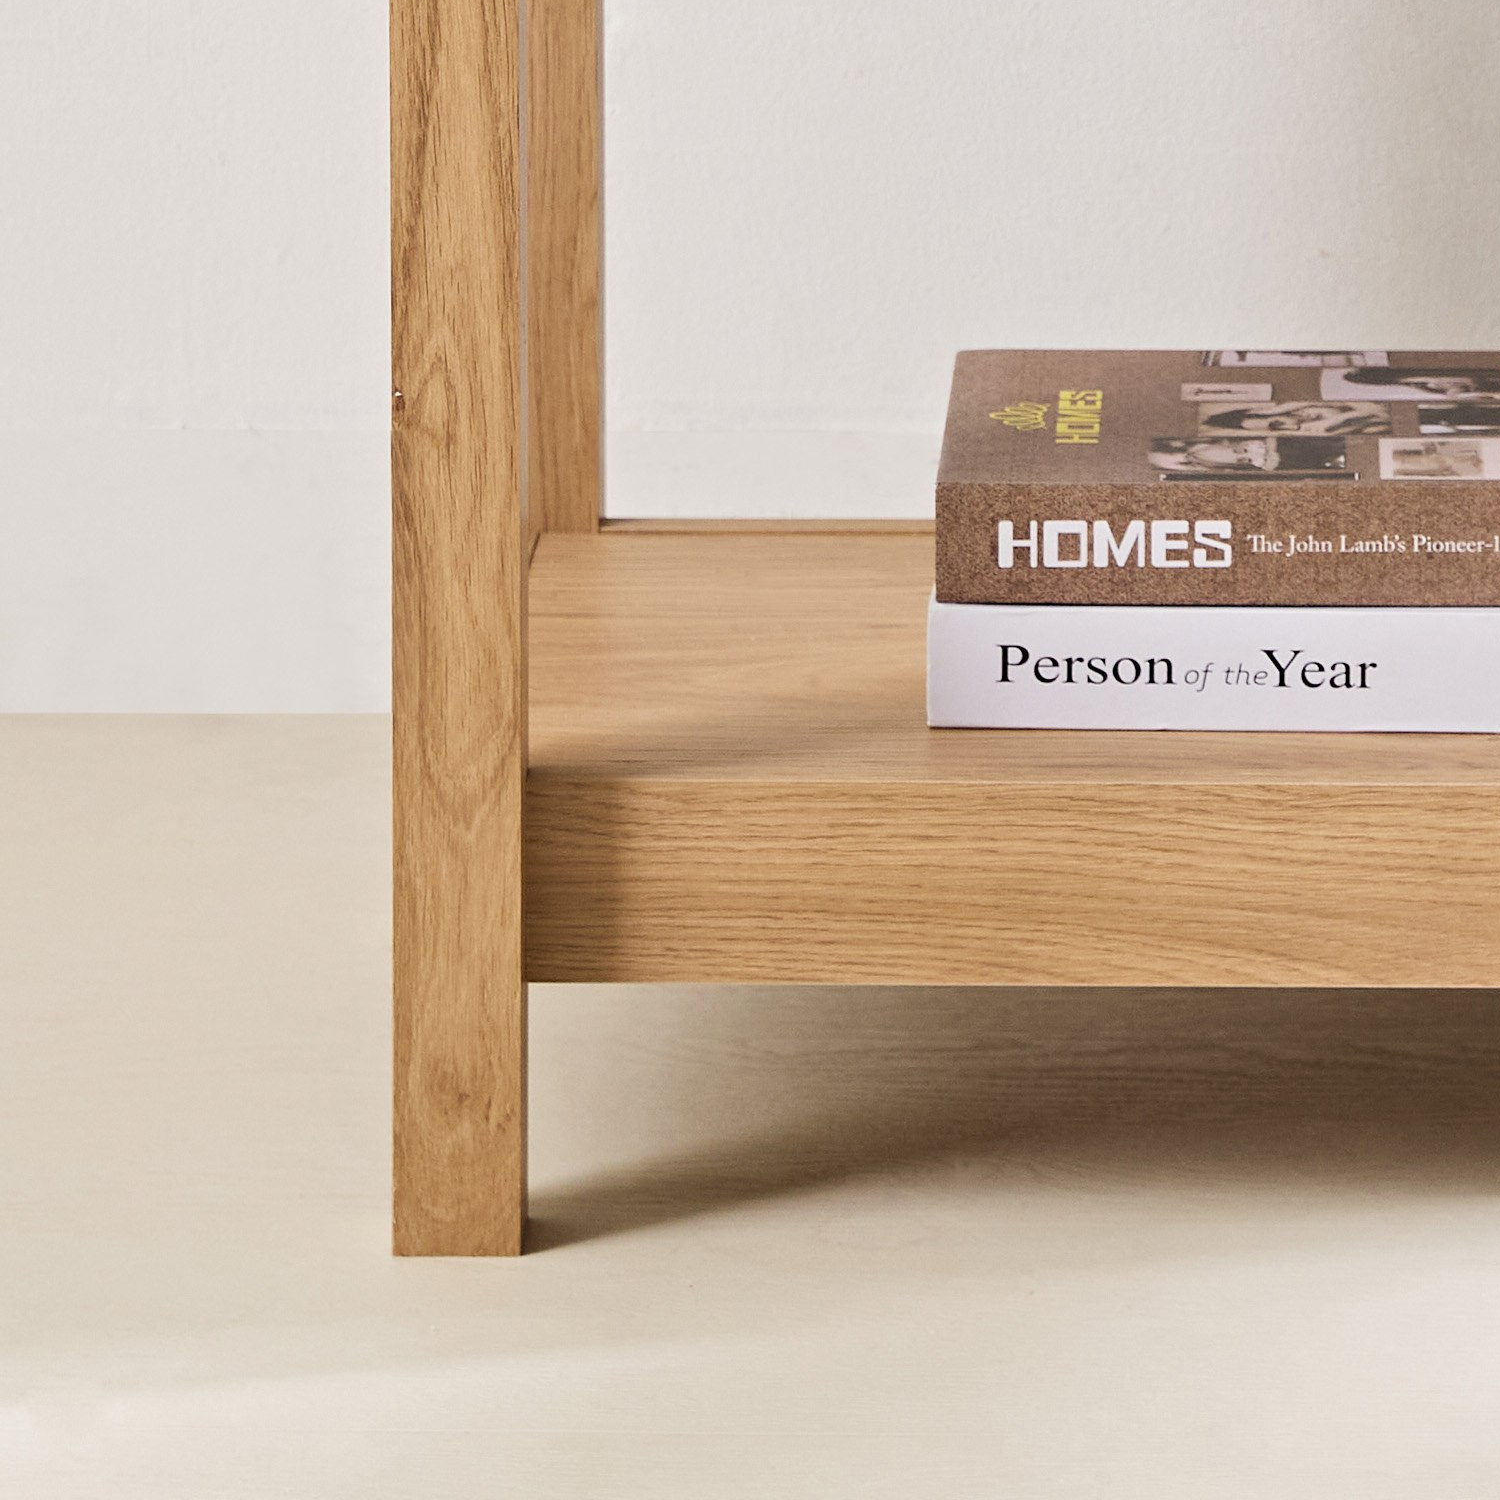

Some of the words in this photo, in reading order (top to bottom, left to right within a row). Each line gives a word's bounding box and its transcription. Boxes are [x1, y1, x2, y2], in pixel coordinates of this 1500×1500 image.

[1055, 390, 1103, 444] HOMES
[998, 519, 1232, 568] HOMES
[1246, 534, 1283, 553] The
[1285, 534, 1333, 557] John
[995, 644, 1177, 685] Person
[1184, 662, 1215, 693] of
[1224, 663, 1268, 686] the
[1260, 648, 1378, 690] Year
